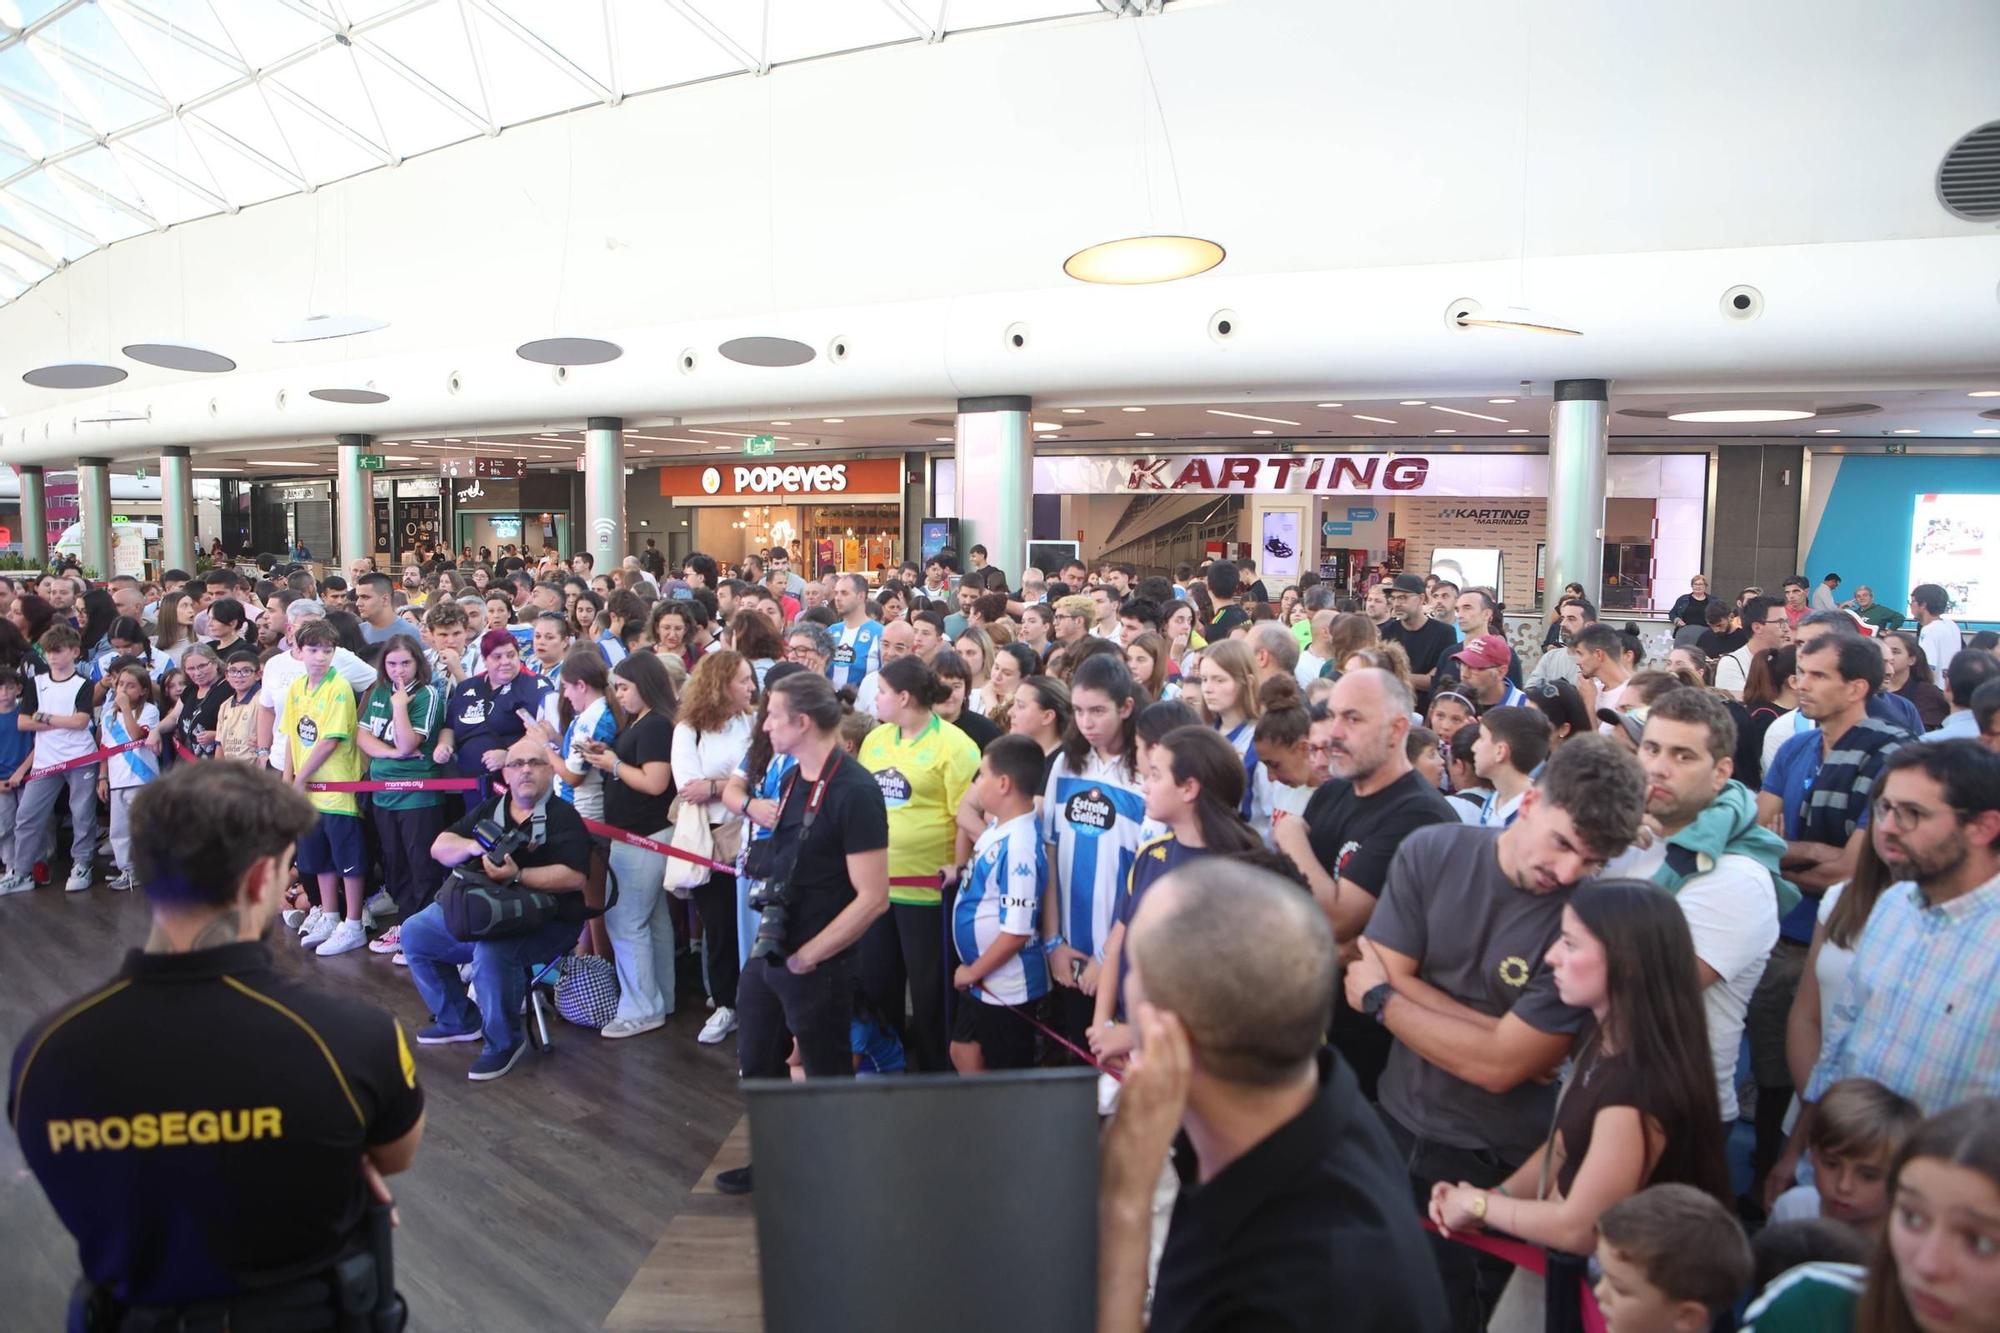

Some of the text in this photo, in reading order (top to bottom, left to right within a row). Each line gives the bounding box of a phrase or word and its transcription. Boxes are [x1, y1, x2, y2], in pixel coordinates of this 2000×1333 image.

[479, 462, 485, 472] 2
[1128, 457, 1429, 490] KARTING
[1456, 509, 1530, 519] KARTING
[881, 786, 904, 798] alicia
[1072, 796, 1109, 816] Estrella
[1071, 808, 1105, 827] Galicia
[47, 1106, 283, 1154] PROSEGUR
